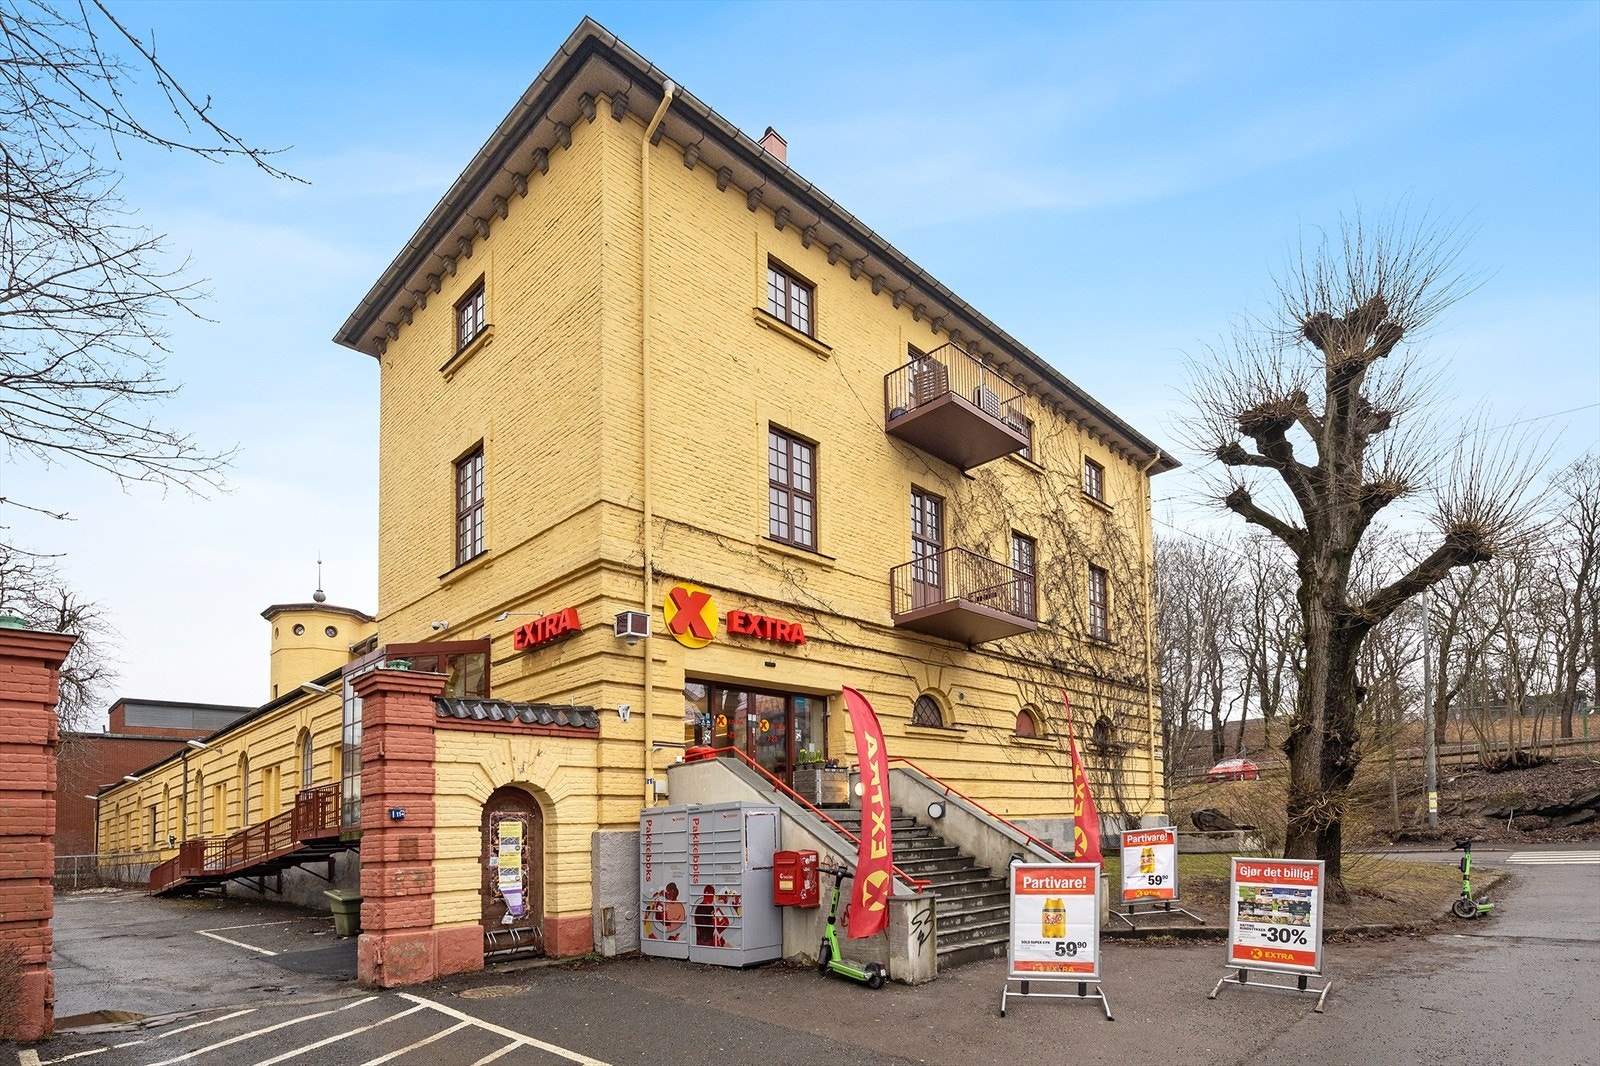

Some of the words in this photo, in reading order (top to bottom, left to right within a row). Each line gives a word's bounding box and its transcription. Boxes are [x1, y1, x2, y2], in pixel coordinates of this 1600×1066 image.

[513, 608, 579, 651] EXTRA
[728, 610, 807, 646] EXTRA
[1074, 764, 1085, 817] EXT
[1127, 833, 1168, 843] Partivare!
[645, 819, 653, 882] Pakkeboks
[692, 817, 700, 884] Pakkeboks
[1148, 875, 1163, 886] 59
[1240, 866, 1262, 878] Gjør
[1263, 867, 1282, 877] det
[1283, 868, 1314, 880] billig!
[1023, 876, 1087, 889] Partivare!
[1261, 927, 1308, 945] -30%
[1055, 941, 1078, 957] 59
[1077, 941, 1087, 949] 90
[1265, 951, 1295, 960] EXTRA
